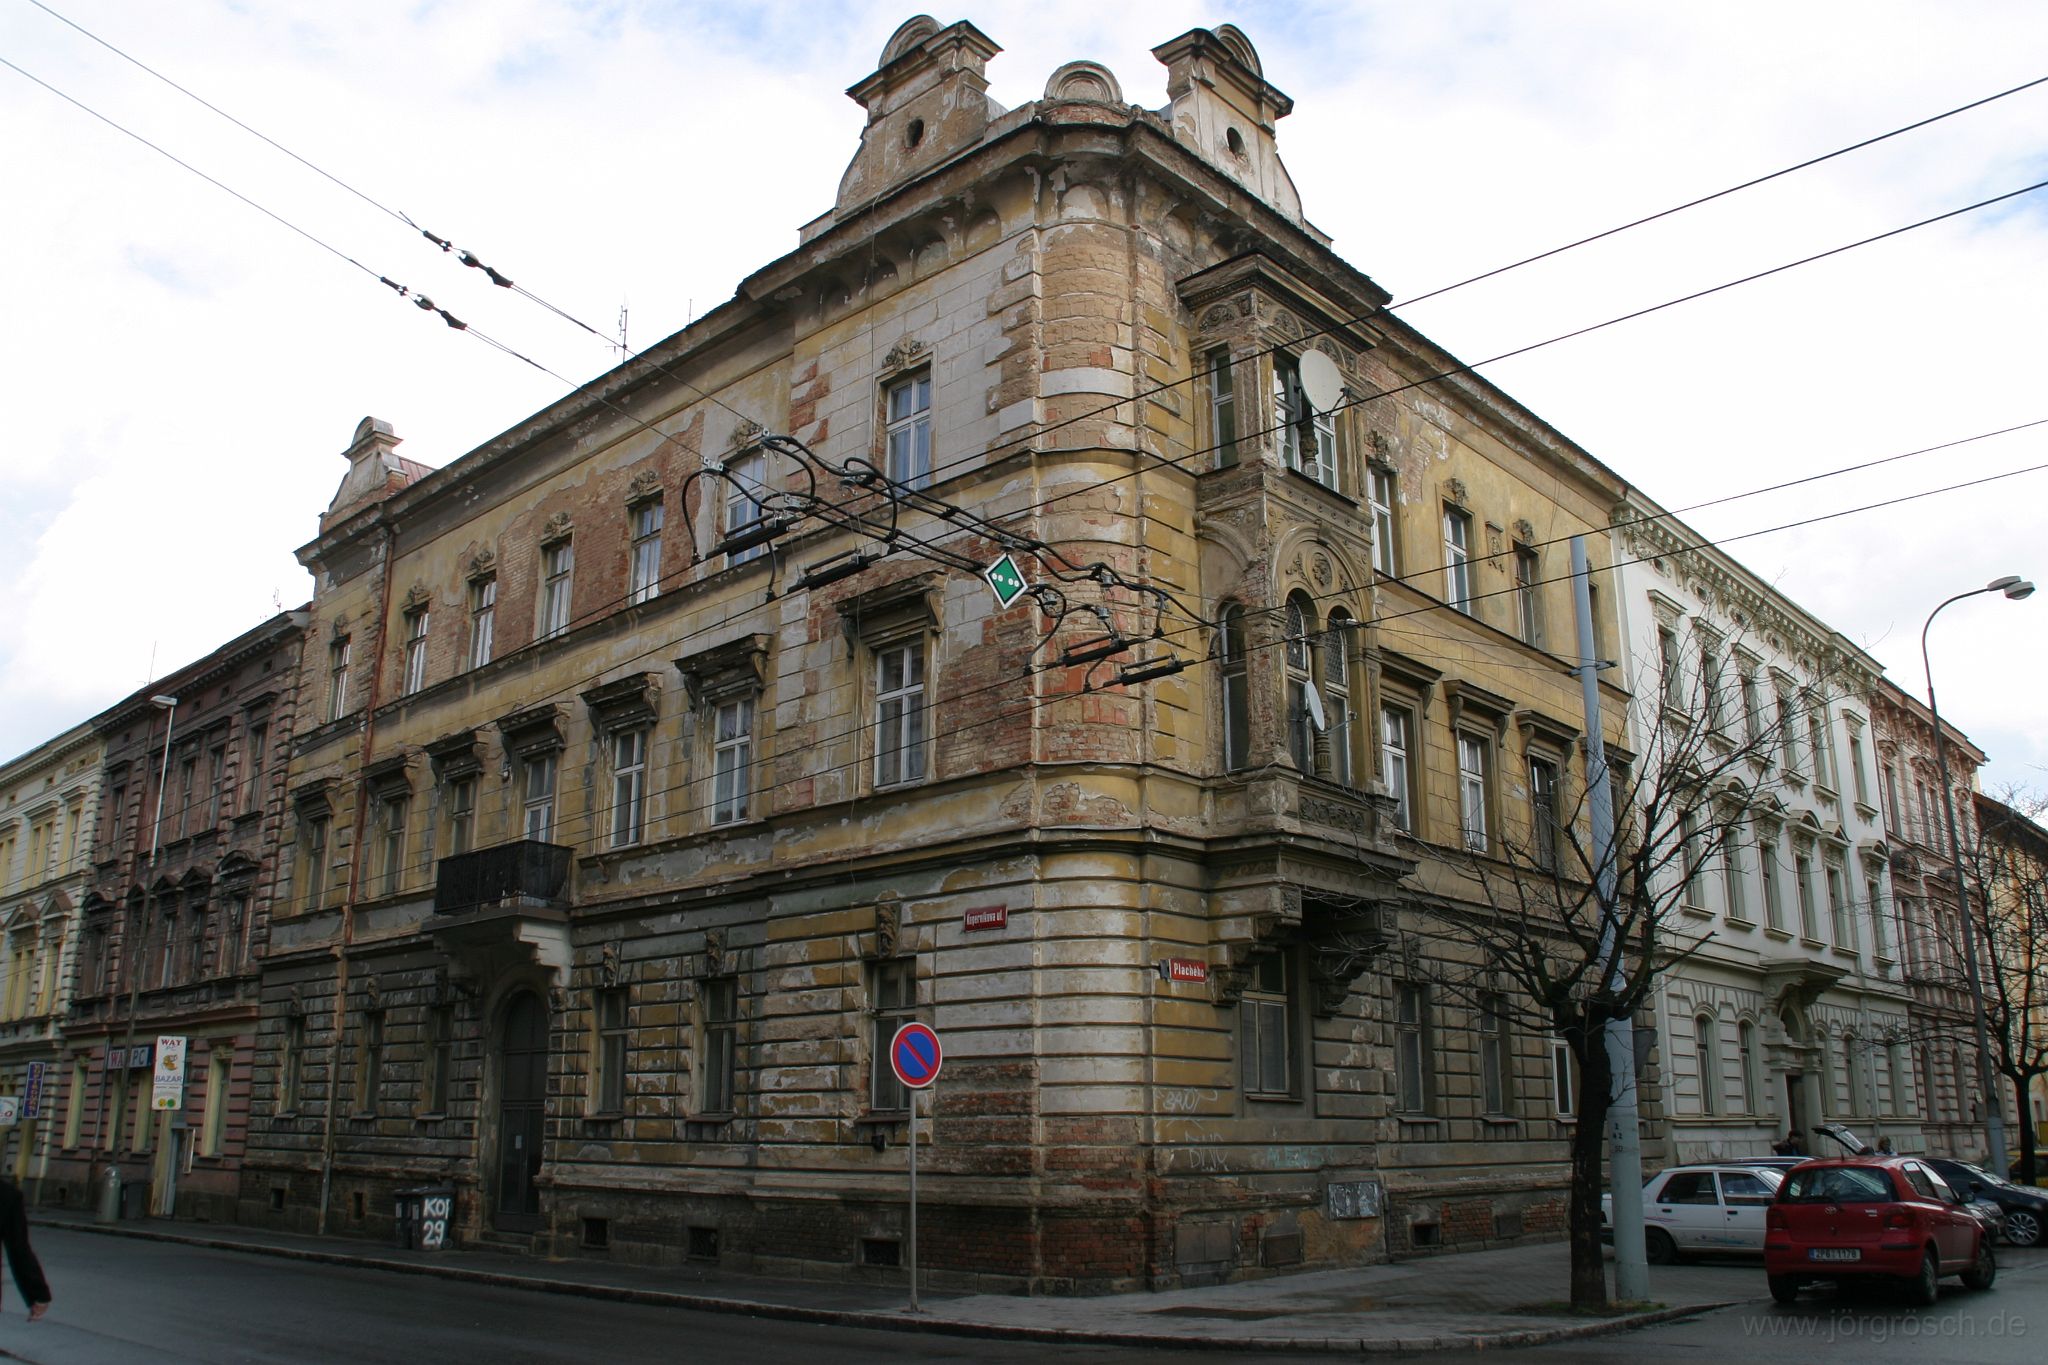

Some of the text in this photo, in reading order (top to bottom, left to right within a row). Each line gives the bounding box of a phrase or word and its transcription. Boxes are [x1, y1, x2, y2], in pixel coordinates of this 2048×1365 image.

[161, 1038, 182, 1046] WAY
[131, 1049, 145, 1065] PC
[155, 1075, 183, 1083] BAZAR
[422, 1220, 445, 1245] 29
